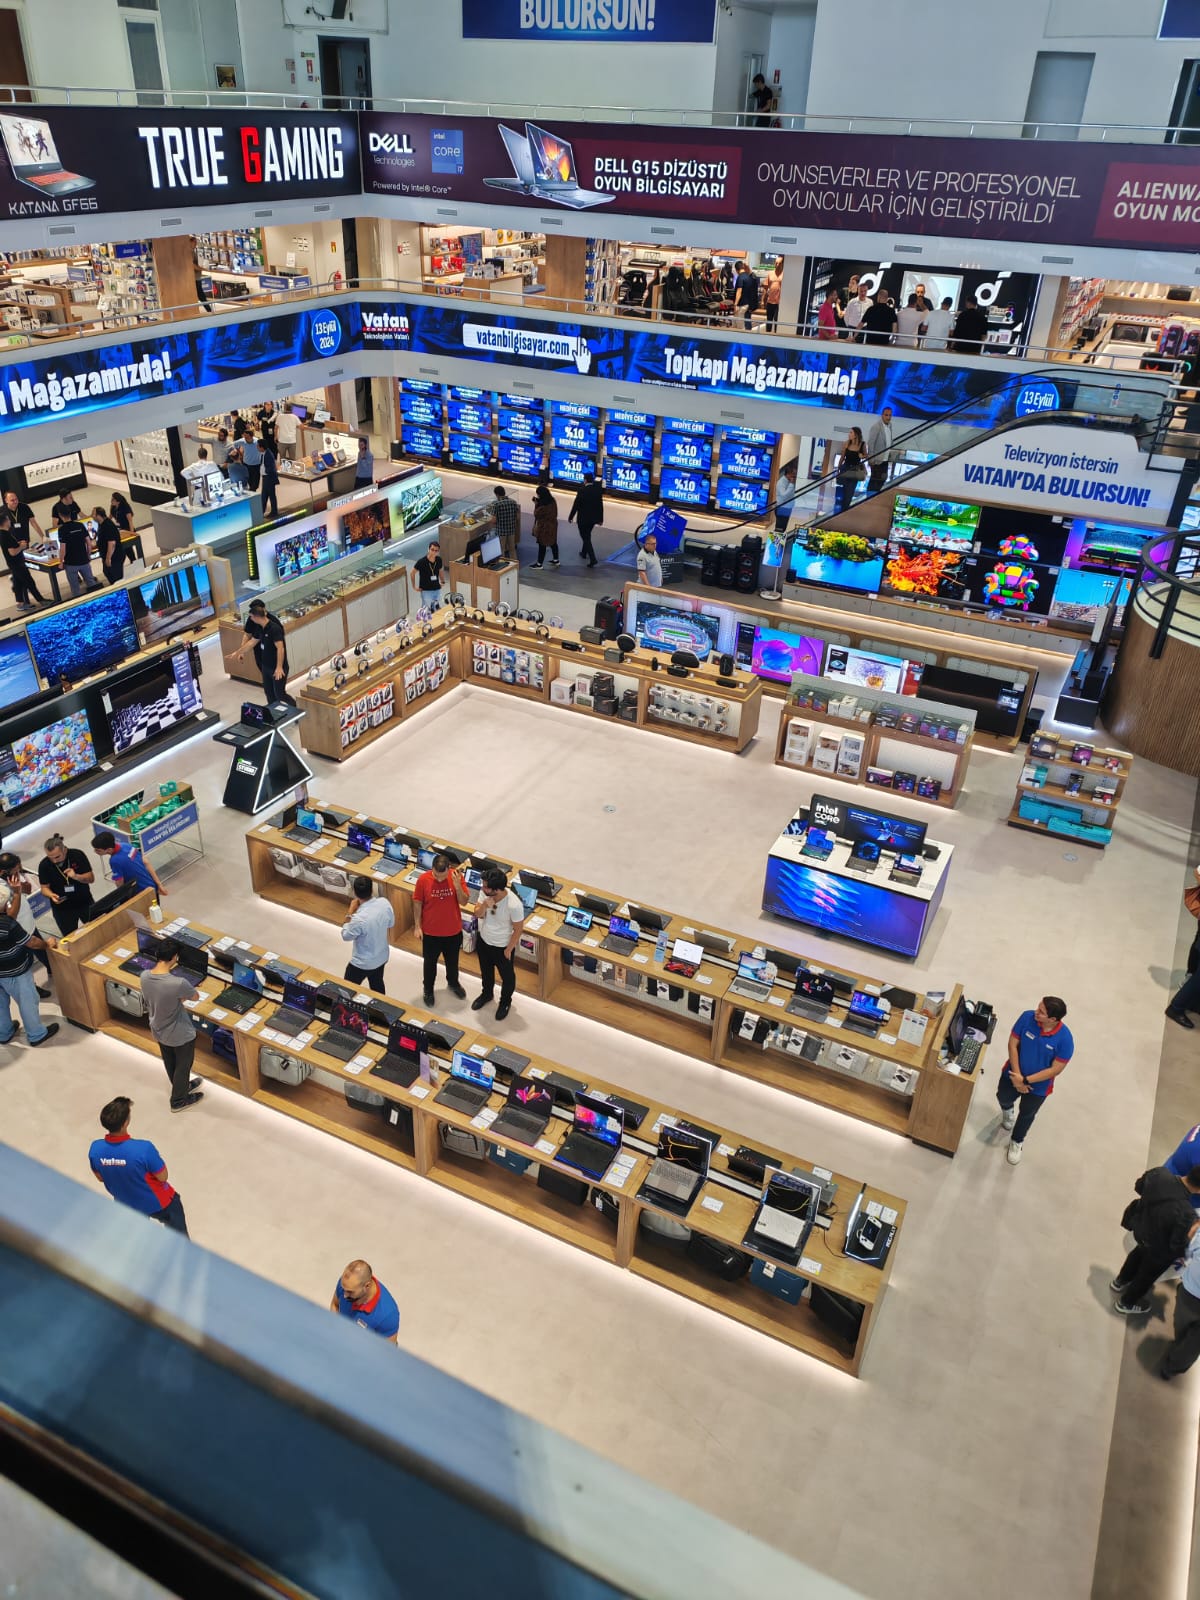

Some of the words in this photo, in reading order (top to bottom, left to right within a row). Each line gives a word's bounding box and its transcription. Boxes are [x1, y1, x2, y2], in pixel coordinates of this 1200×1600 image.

[520, 0, 656, 31] BULURSUN!
[369, 132, 413, 154] DELL
[138, 127, 228, 189] TRUE
[240, 127, 344, 183] GAMING
[374, 155, 416, 168] Technologies
[594, 157, 628, 174] DELL
[632, 159, 660, 176] G15
[663, 159, 728, 180] DİZÜSTÜ
[372, 181, 401, 190] Powered
[402, 183, 410, 192] by
[594, 176, 632, 192] OYUN
[635, 176, 725, 199] BİLGİSAYARI
[757, 162, 901, 189] OYUNSEVERLER
[905, 169, 931, 191] VE
[933, 171, 1081, 198] PROFESYONEL
[8, 200, 60, 215] KATANA
[62, 198, 98, 212] GF66
[773, 189, 884, 213] OYUNCULAR
[888, 191, 926, 219] İÇİN
[930, 195, 1056, 224] GELİŞTİRİLDİ
[1113, 202, 1168, 221] OYUN
[315, 322, 322, 335] 13
[323, 320, 337, 336] Eylül
[361, 312, 409, 328] Vatan
[320, 336, 335, 349] 2024
[476, 330, 569, 357] vatanbilgisayar.com
[664, 347, 728, 386] Topkapı
[731, 356, 858, 397] Mağazamızda!
[8, 351, 171, 412] Mağazamızda!
[1023, 391, 1034, 405] 13
[1034, 392, 1054, 408] Eylül
[565, 426, 584, 439] %10
[619, 435, 639, 448] %10
[676, 443, 697, 457] %10
[563, 459, 582, 472] %10
[735, 453, 756, 467] %10
[1004, 444, 1067, 469] Televizyon
[1069, 452, 1118, 474] istersin
[616, 467, 636, 481] %10
[675, 479, 696, 492] %10
[964, 464, 1045, 493] VATAN'DA
[1048, 476, 1151, 507] BULURSUN!
[732, 488, 753, 501] %10
[54, 797, 70, 807] TCL
[815, 803, 839, 817] intel
[100, 1157, 127, 1167] Vatan
